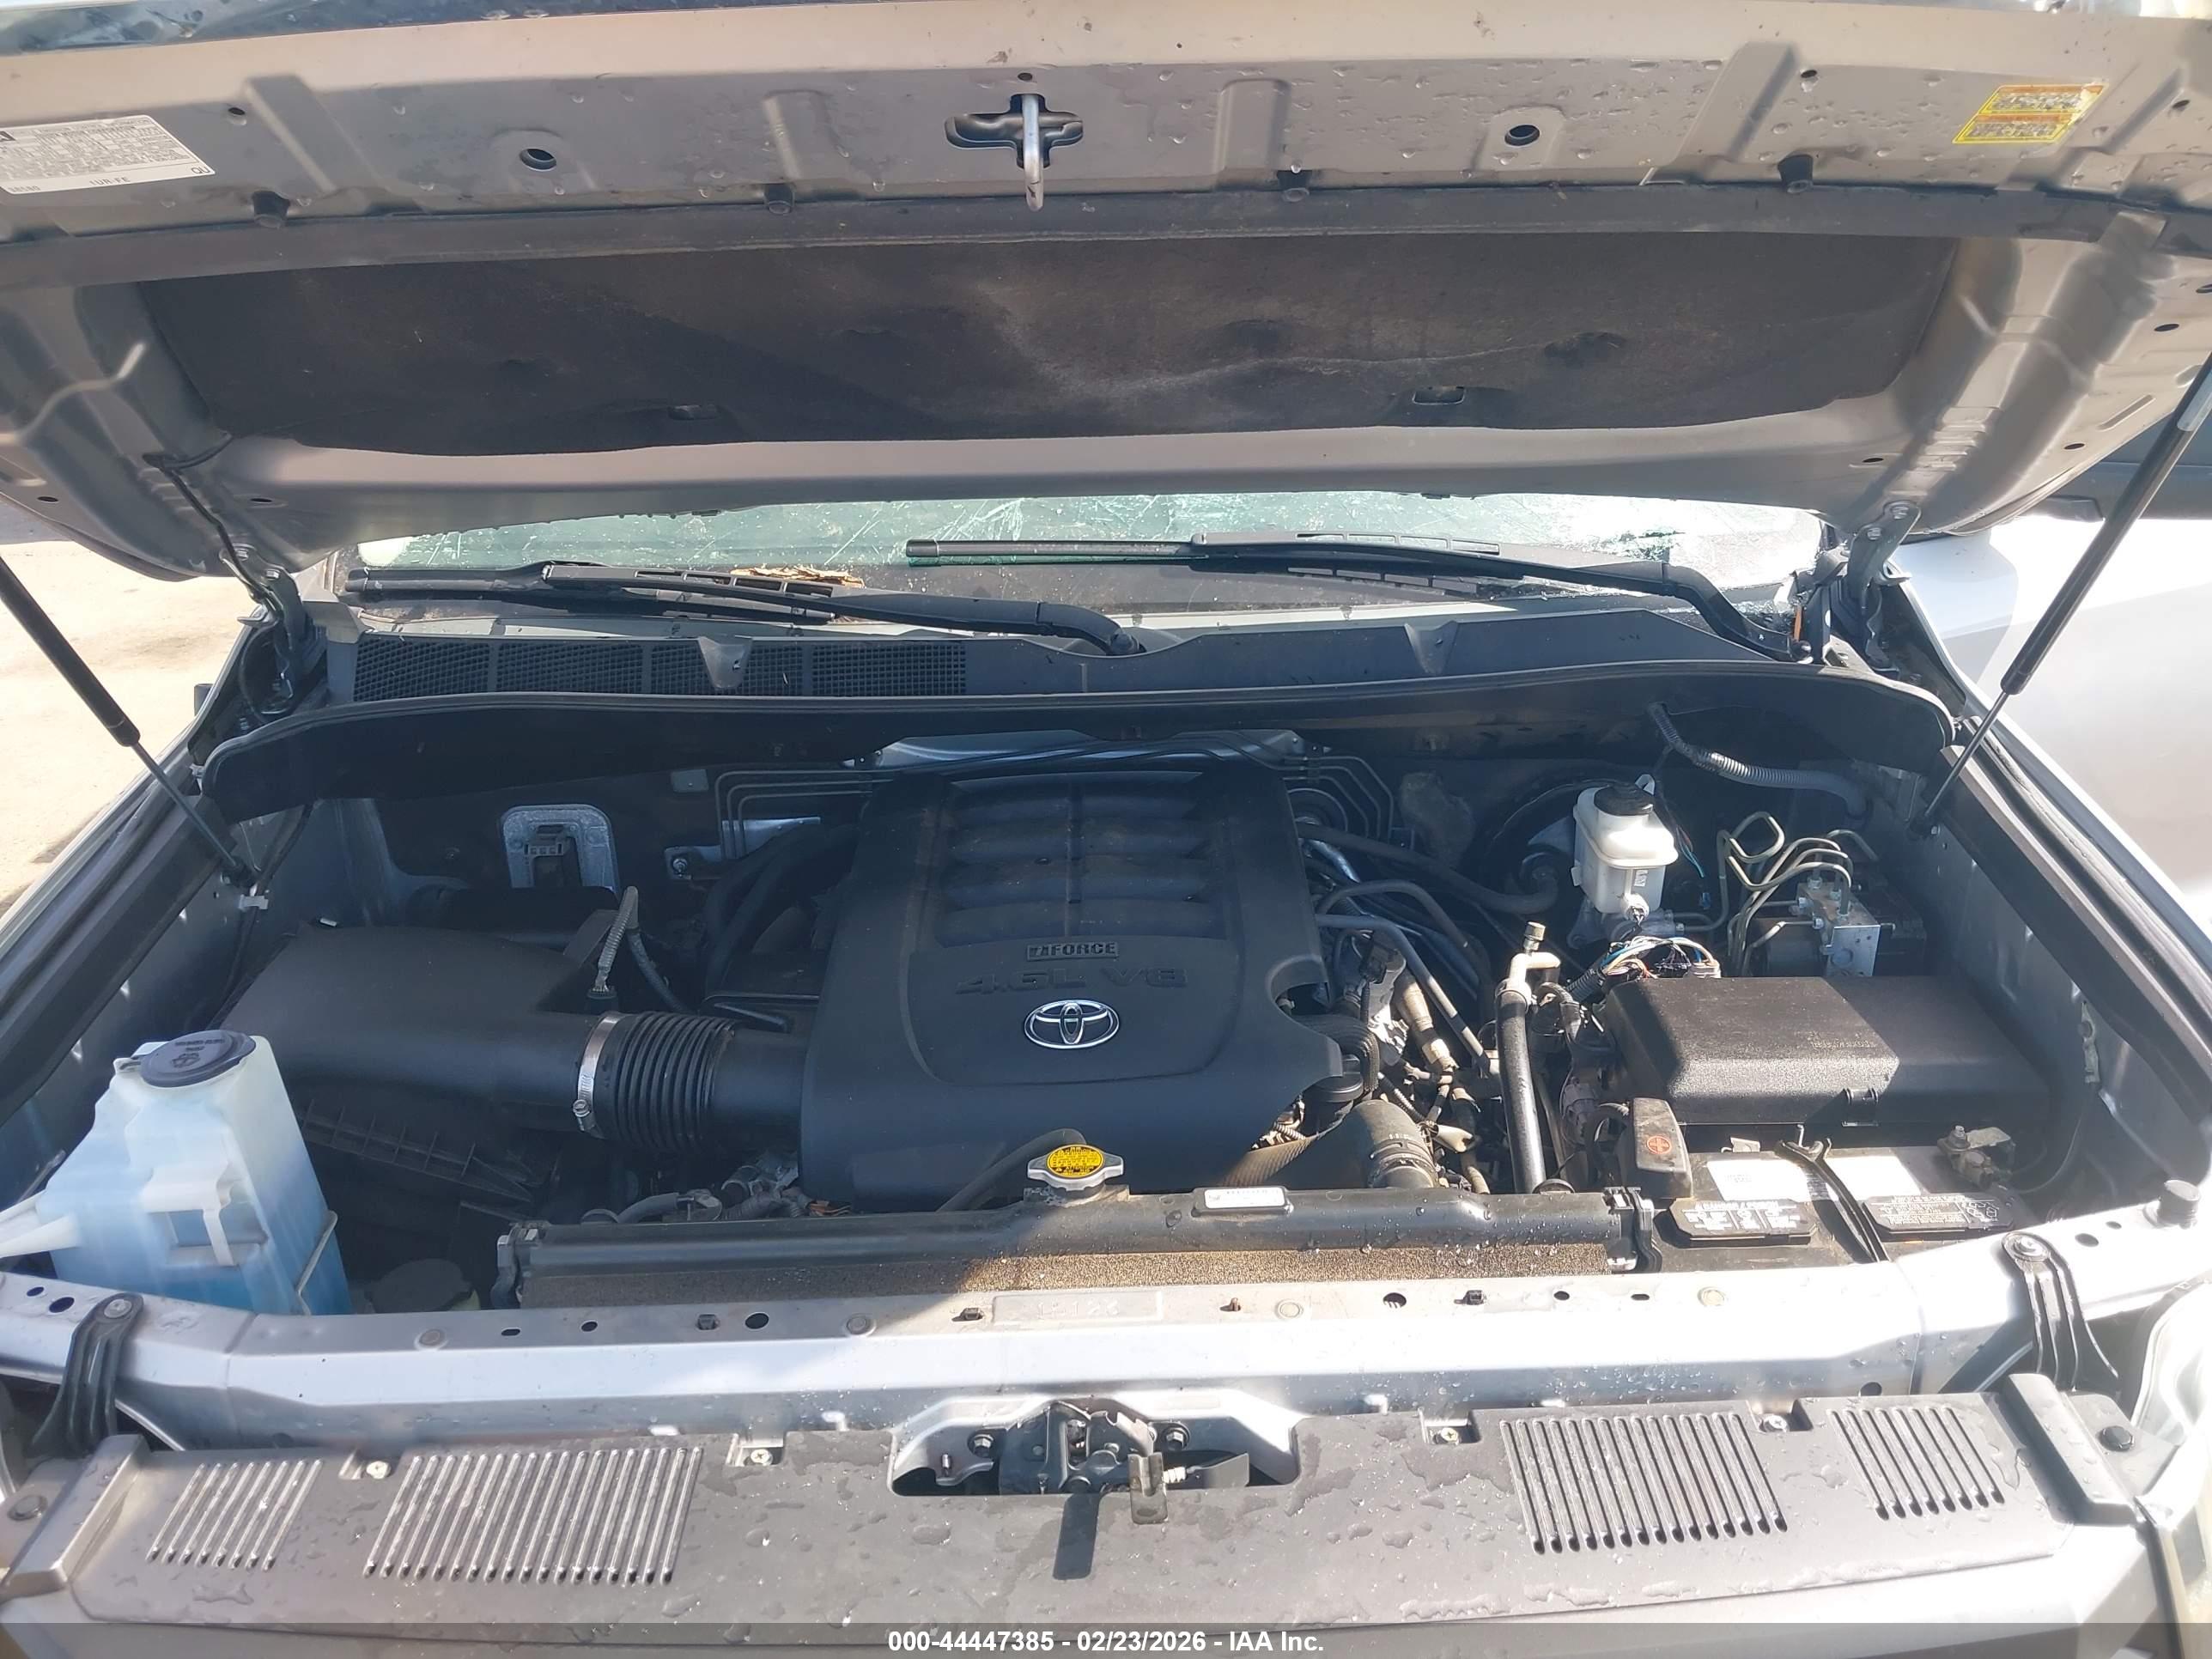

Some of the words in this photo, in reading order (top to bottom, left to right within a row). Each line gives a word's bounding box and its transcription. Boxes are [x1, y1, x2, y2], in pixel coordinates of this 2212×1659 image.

[191, 166, 210, 175] QU
[89, 176, 131, 186] 1UR-FE
[1100, 966, 1188, 988] V8
